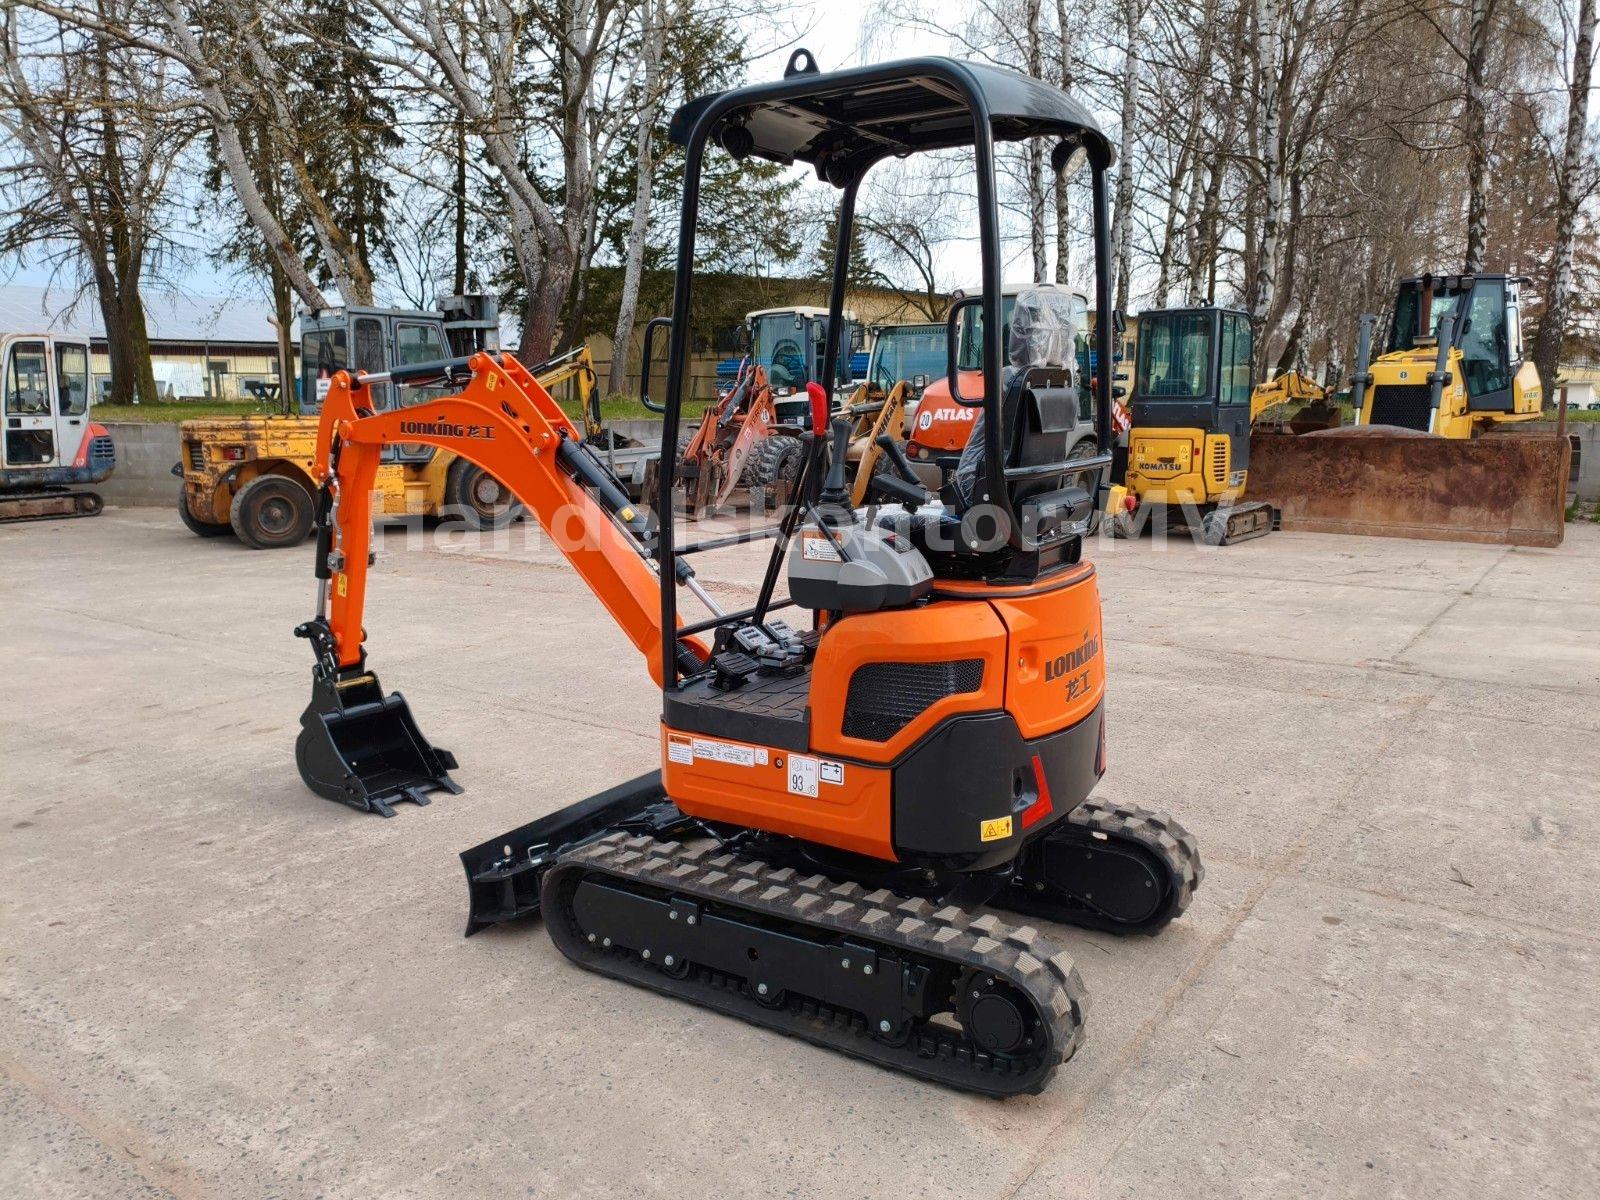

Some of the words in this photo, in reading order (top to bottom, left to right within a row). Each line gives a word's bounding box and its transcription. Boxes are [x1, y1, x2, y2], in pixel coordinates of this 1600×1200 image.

[921, 413, 930, 427] 20
[933, 408, 974, 421] ATLAS
[1139, 463, 1181, 471] KOMATSU
[1065, 669, 1091, 702] 龙工
[792, 774, 804, 791] 93
